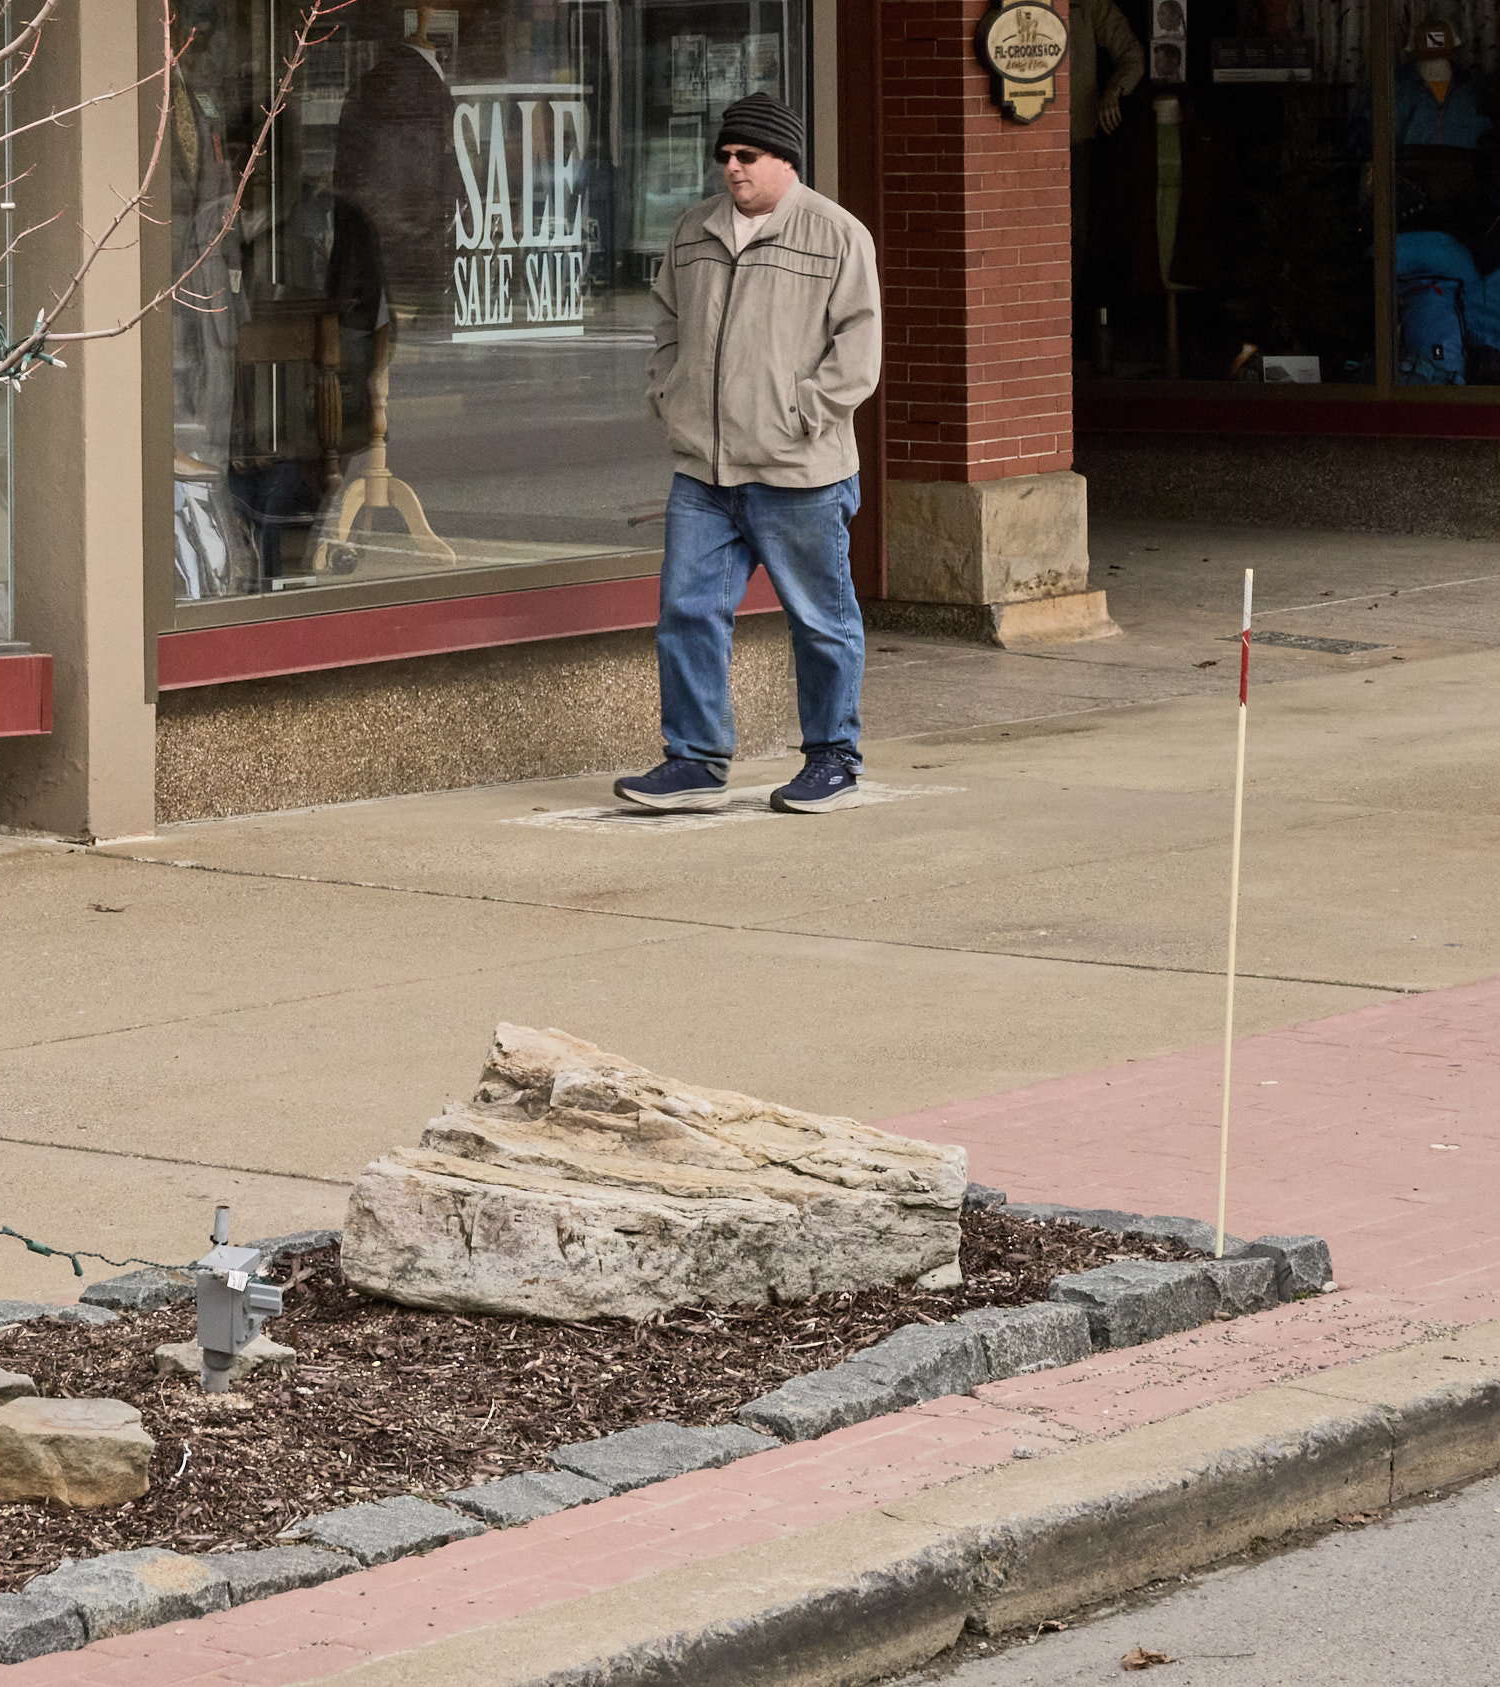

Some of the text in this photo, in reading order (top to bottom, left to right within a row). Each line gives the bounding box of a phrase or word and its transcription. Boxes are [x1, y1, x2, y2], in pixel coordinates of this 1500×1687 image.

[1008, 44, 1043, 58] CROOKS
[453, 100, 584, 250] SALE
[454, 251, 584, 327] SALE SALE
